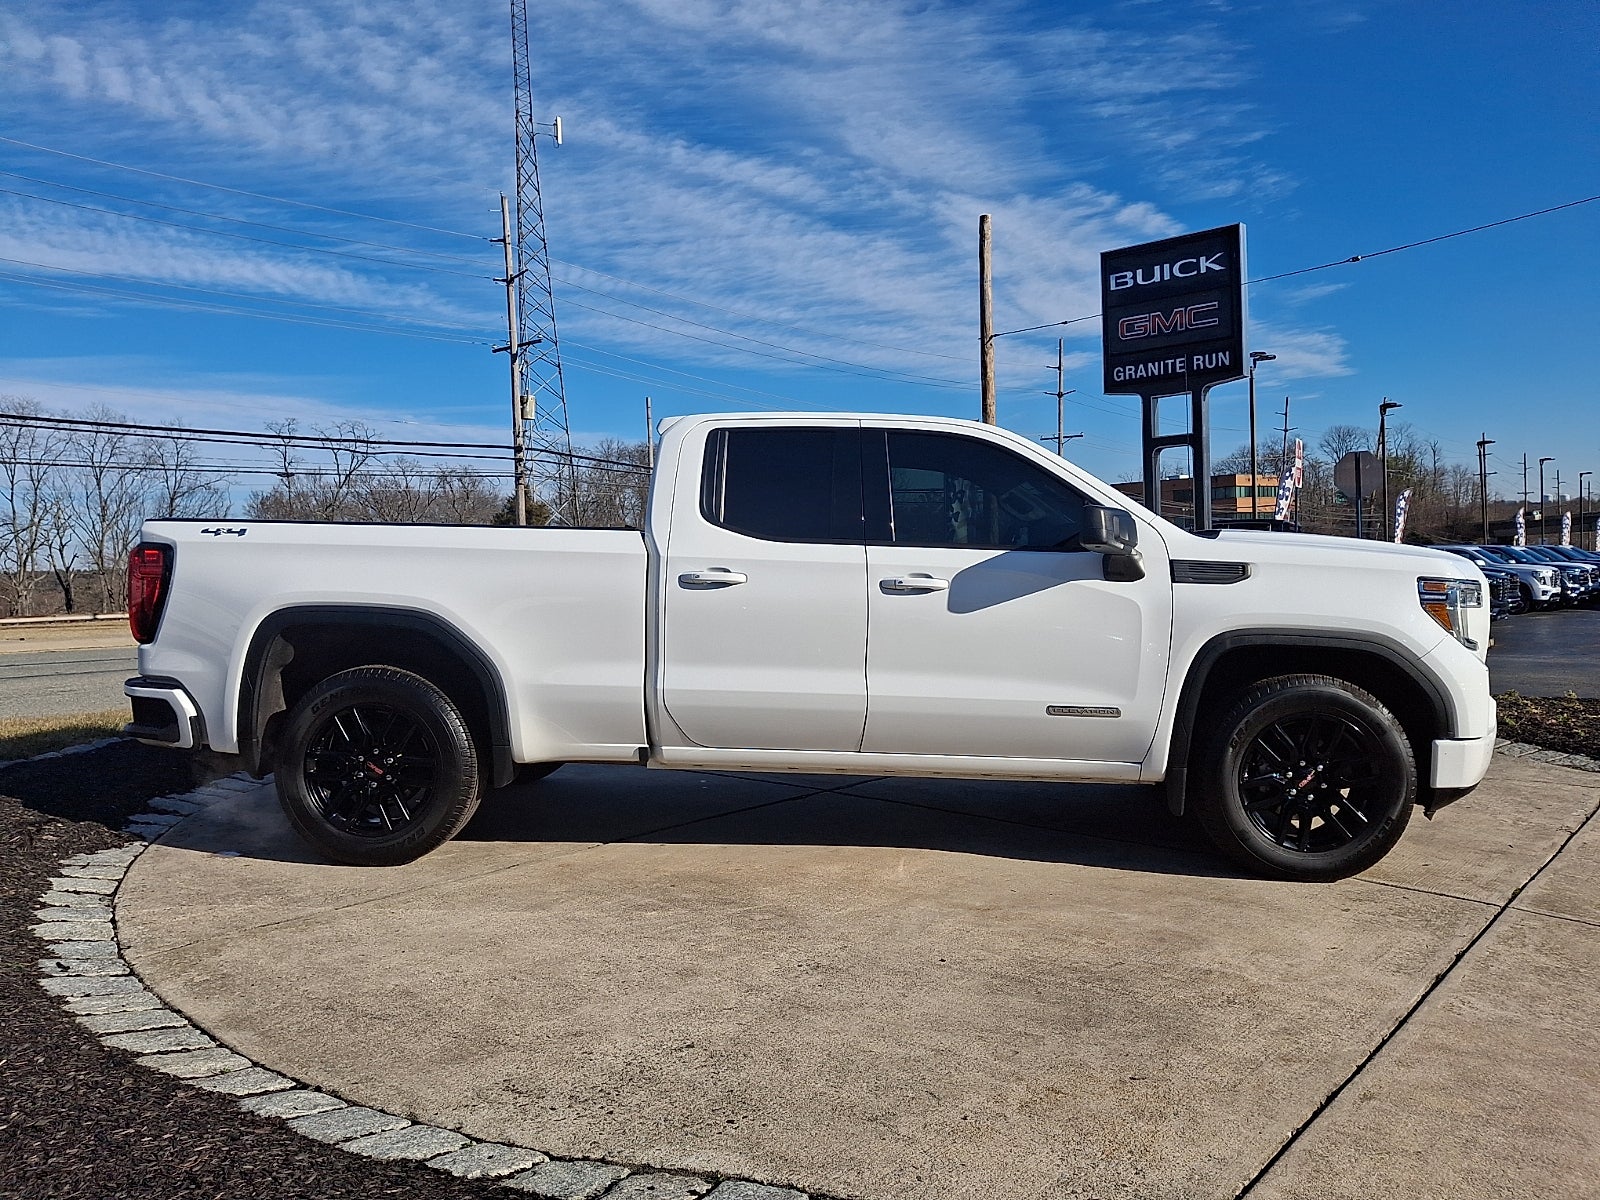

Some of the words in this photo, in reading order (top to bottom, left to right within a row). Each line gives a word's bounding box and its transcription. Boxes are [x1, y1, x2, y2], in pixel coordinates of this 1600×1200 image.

[1109, 251, 1227, 291] BUICK
[1118, 301, 1219, 341] GMC
[1113, 357, 1186, 382] GRANITE
[1193, 350, 1230, 371] RUN
